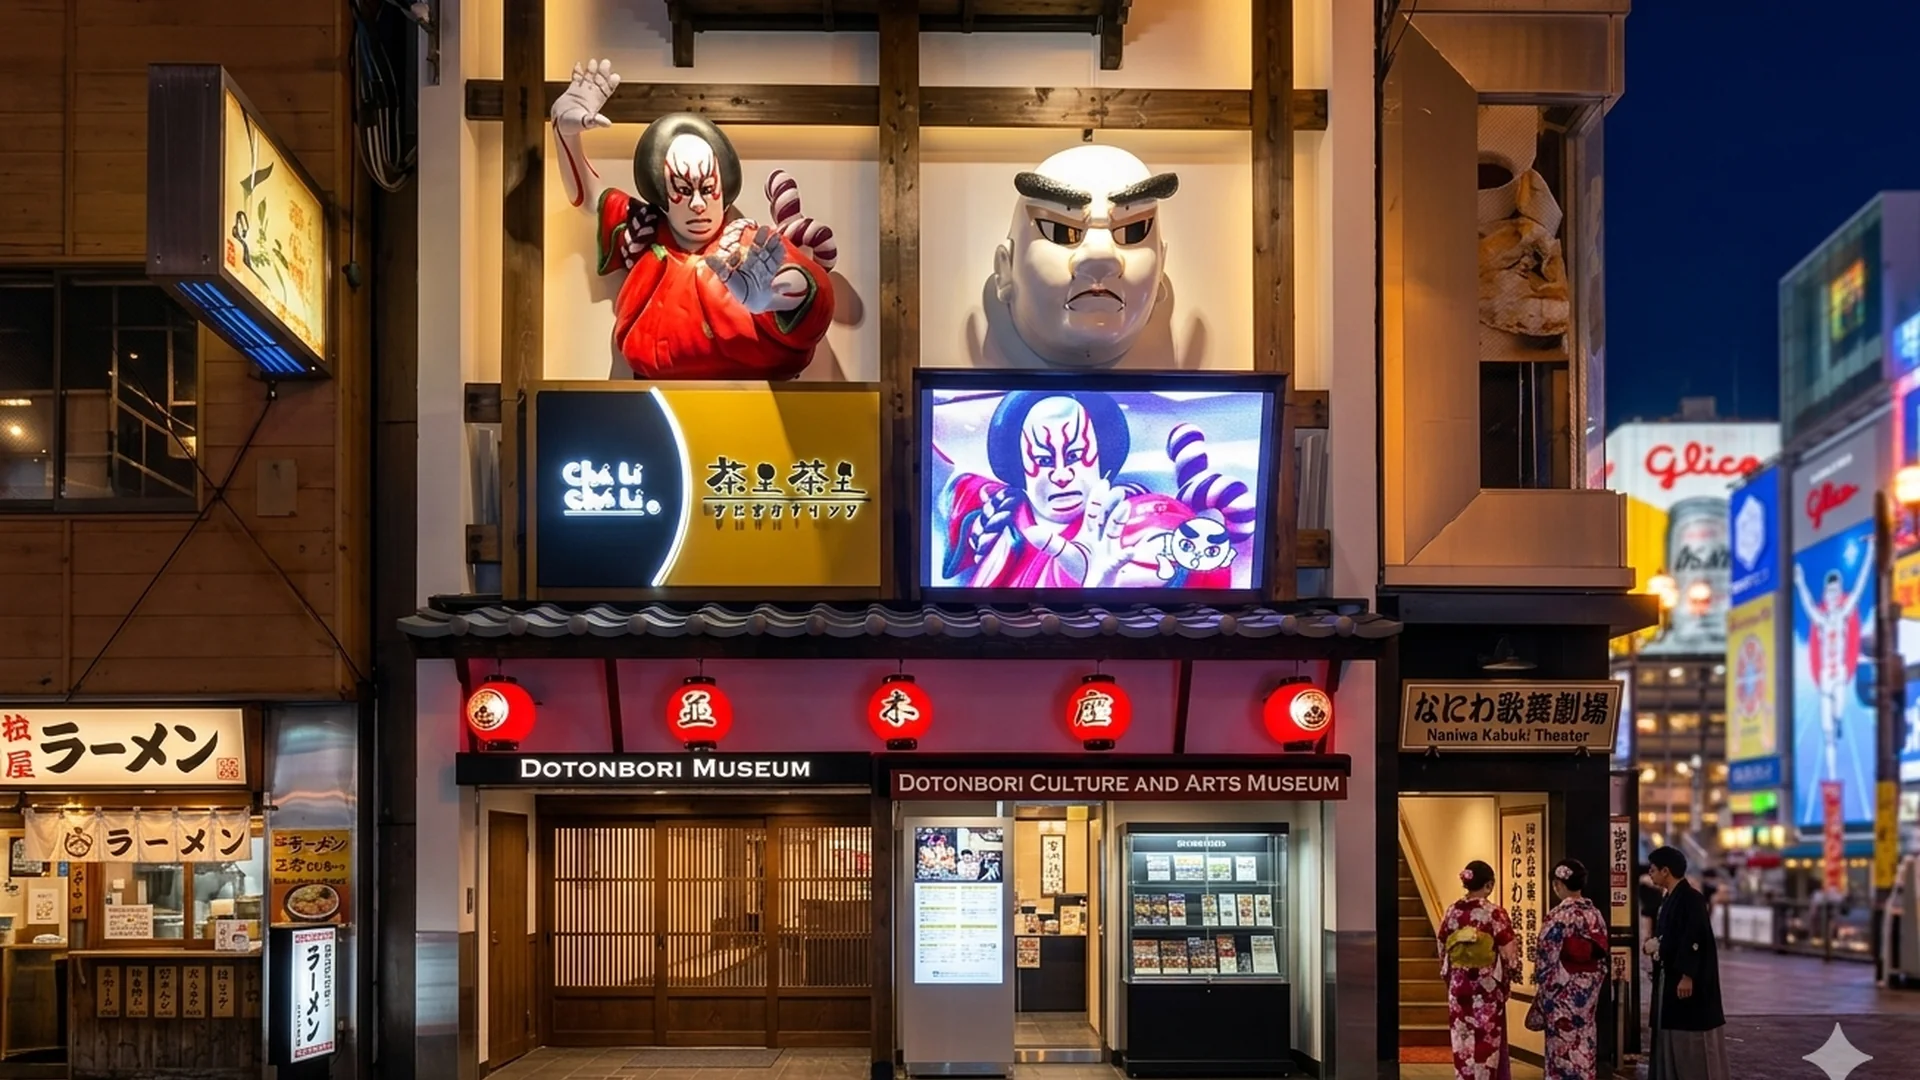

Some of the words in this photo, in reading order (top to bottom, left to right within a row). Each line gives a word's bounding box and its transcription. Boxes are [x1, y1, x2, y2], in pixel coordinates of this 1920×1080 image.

[1645, 441, 1762, 489] Glico
[40, 721, 218, 774] ラーメン
[1427, 728, 1478, 742] Naniwa
[1534, 728, 1590, 742] Theater
[106, 828, 245, 857] ラーメン
[306, 945, 320, 1042] ラーメン
